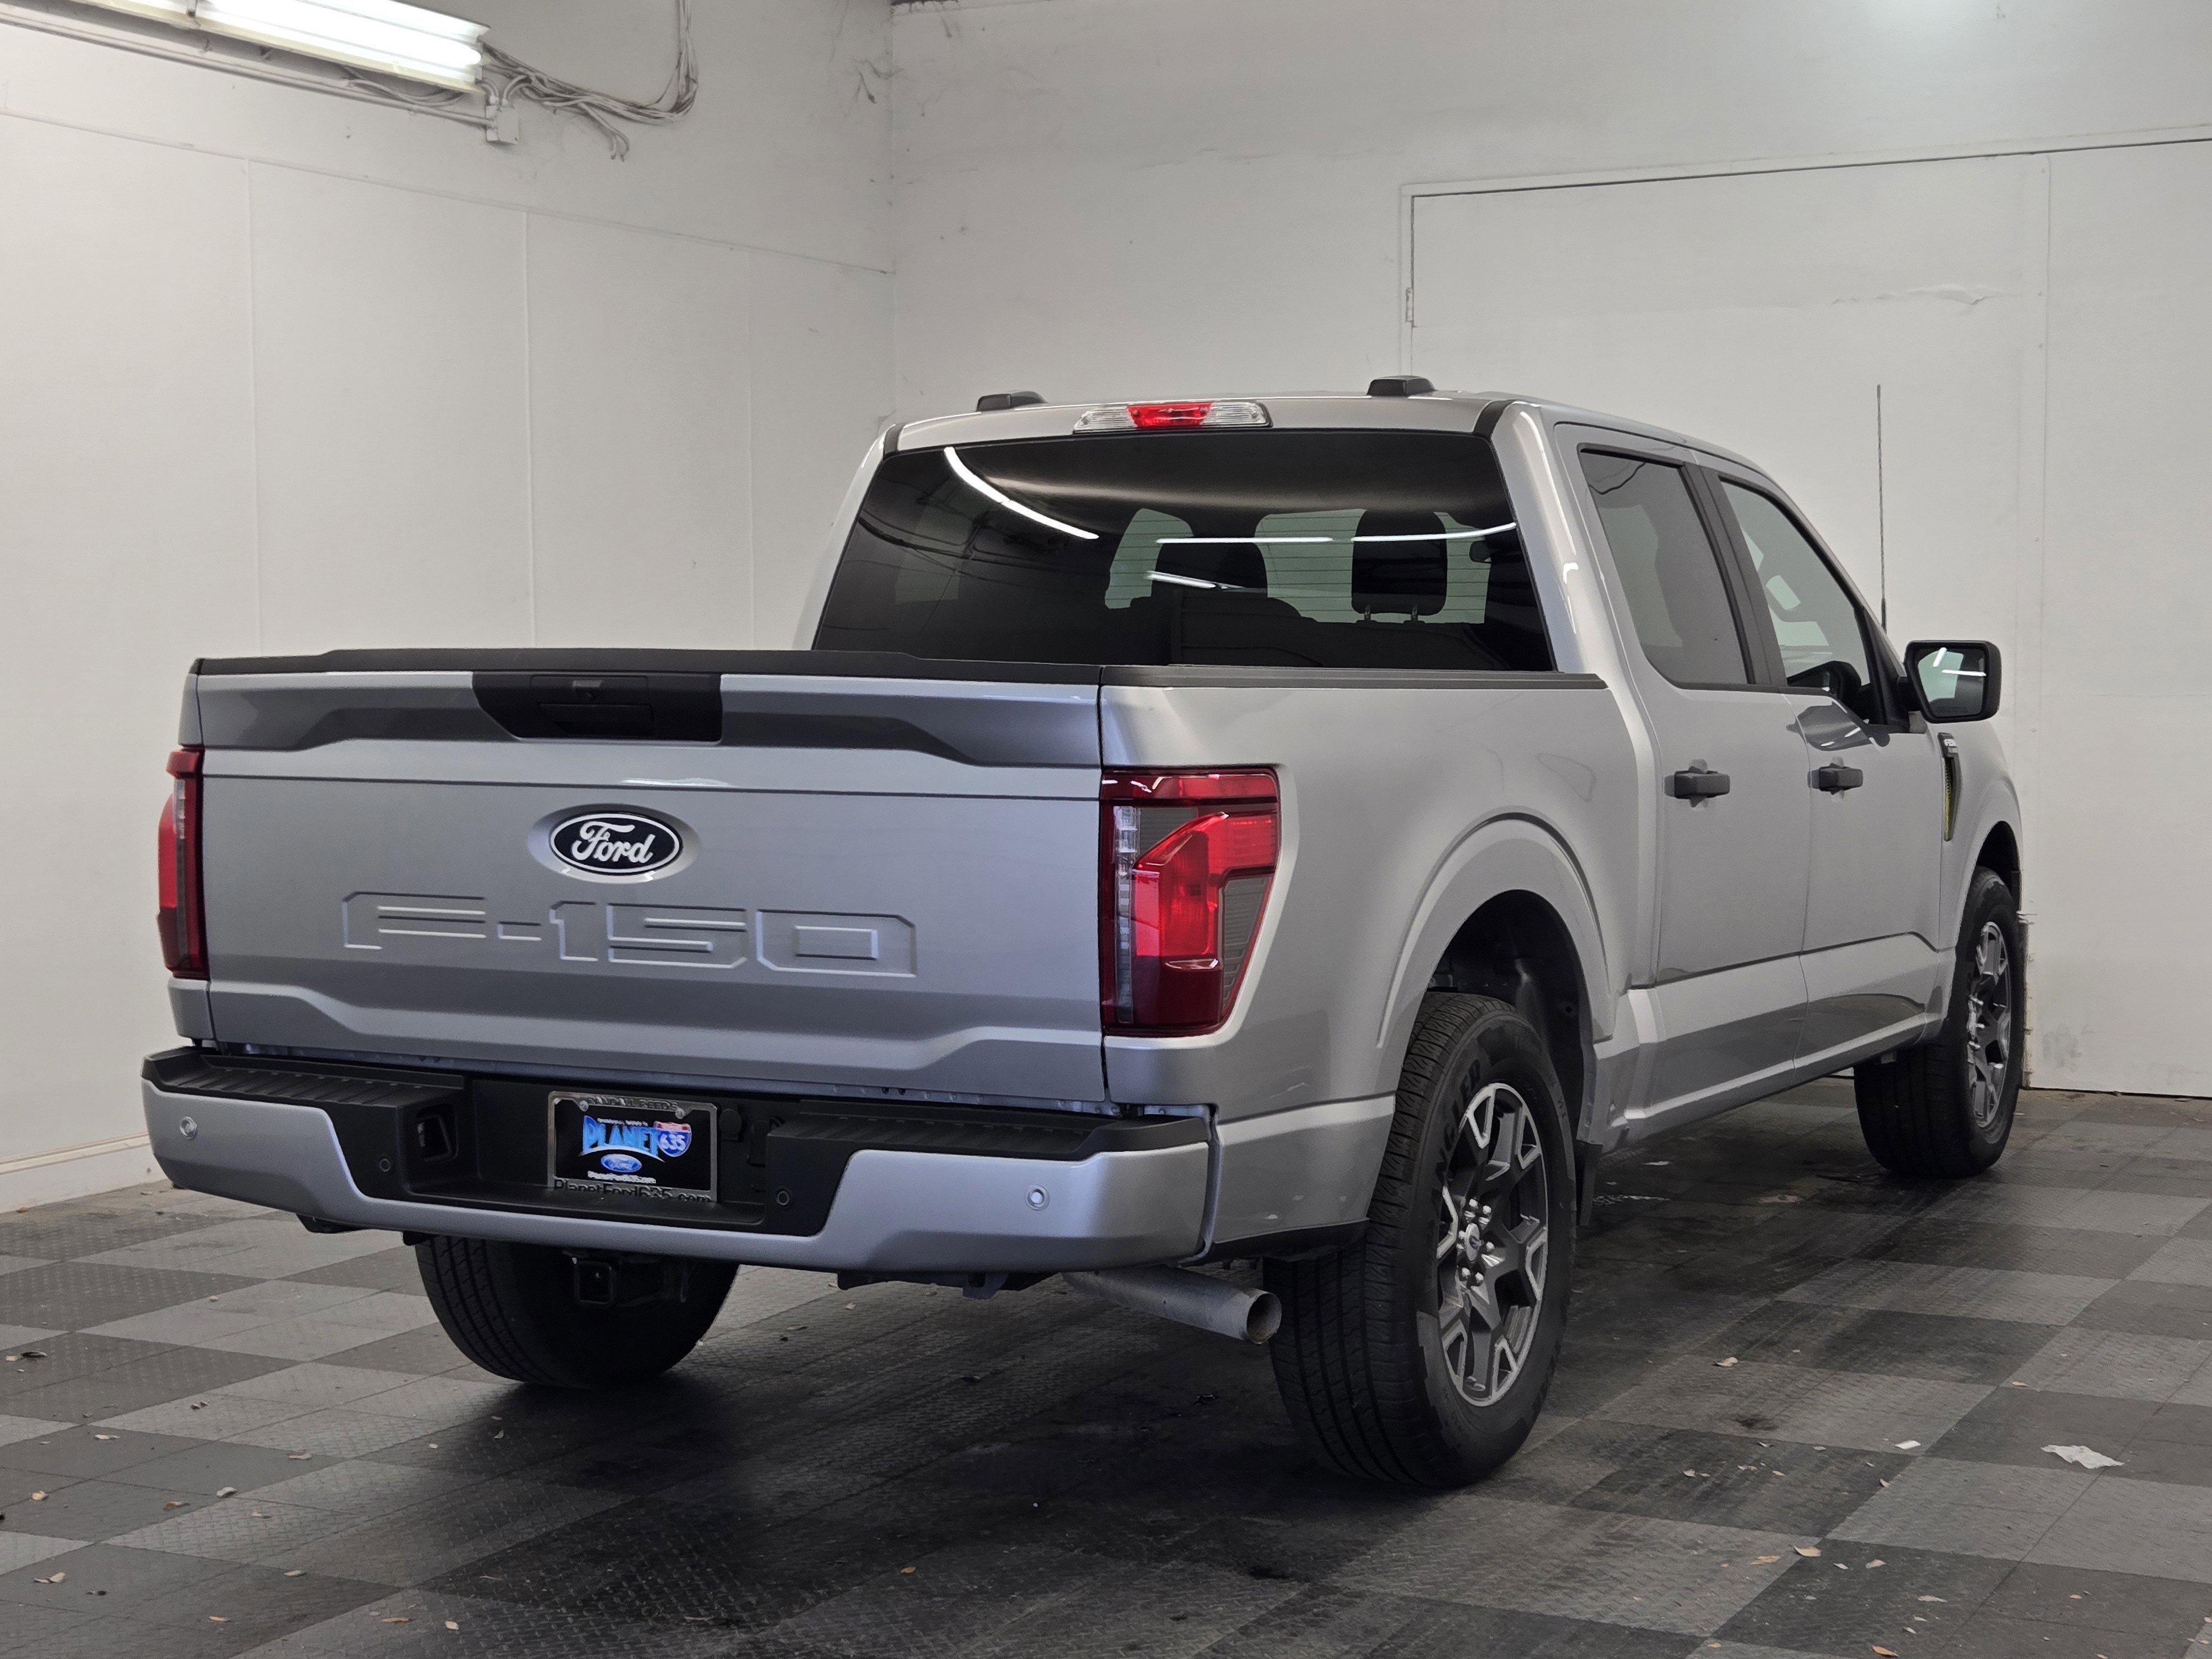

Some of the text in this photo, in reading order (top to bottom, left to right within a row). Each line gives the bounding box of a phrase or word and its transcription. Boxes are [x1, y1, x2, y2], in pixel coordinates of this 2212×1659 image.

[571, 821, 656, 864] Ford
[342, 891, 916, 978] F-150
[582, 1115, 687, 1156] PLANET 635
[554, 1178, 712, 1203] PlanetFord635com
